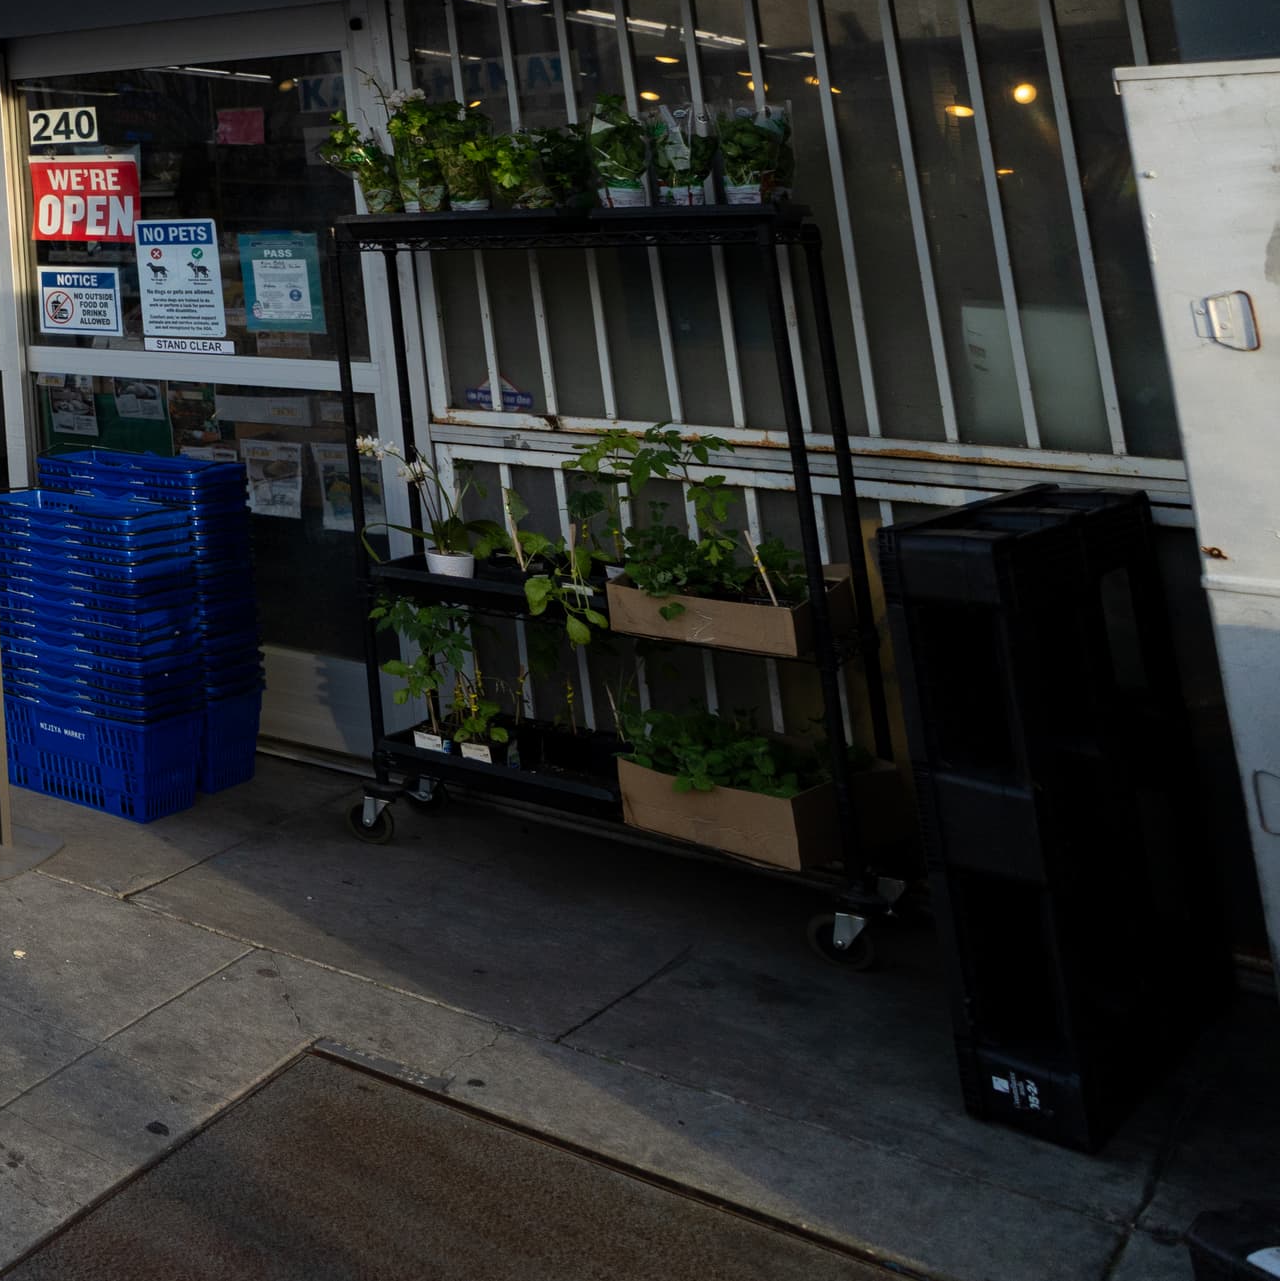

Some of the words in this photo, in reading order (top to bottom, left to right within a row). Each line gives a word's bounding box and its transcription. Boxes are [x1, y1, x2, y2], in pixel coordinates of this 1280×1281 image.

[32, 110, 96, 142] 240
[47, 168, 121, 191] WE'RE
[38, 194, 134, 236] OPEN
[142, 226, 164, 242] NO
[168, 226, 207, 241] PETS
[263, 249, 293, 258] PASS
[56, 273, 98, 287] NOTICE
[74, 292, 83, 300] NO
[85, 292, 113, 301] OUTSIDE
[82, 309, 107, 317] DRINKS
[156, 339, 187, 350] STAND
[190, 341, 222, 352] CLEAR
